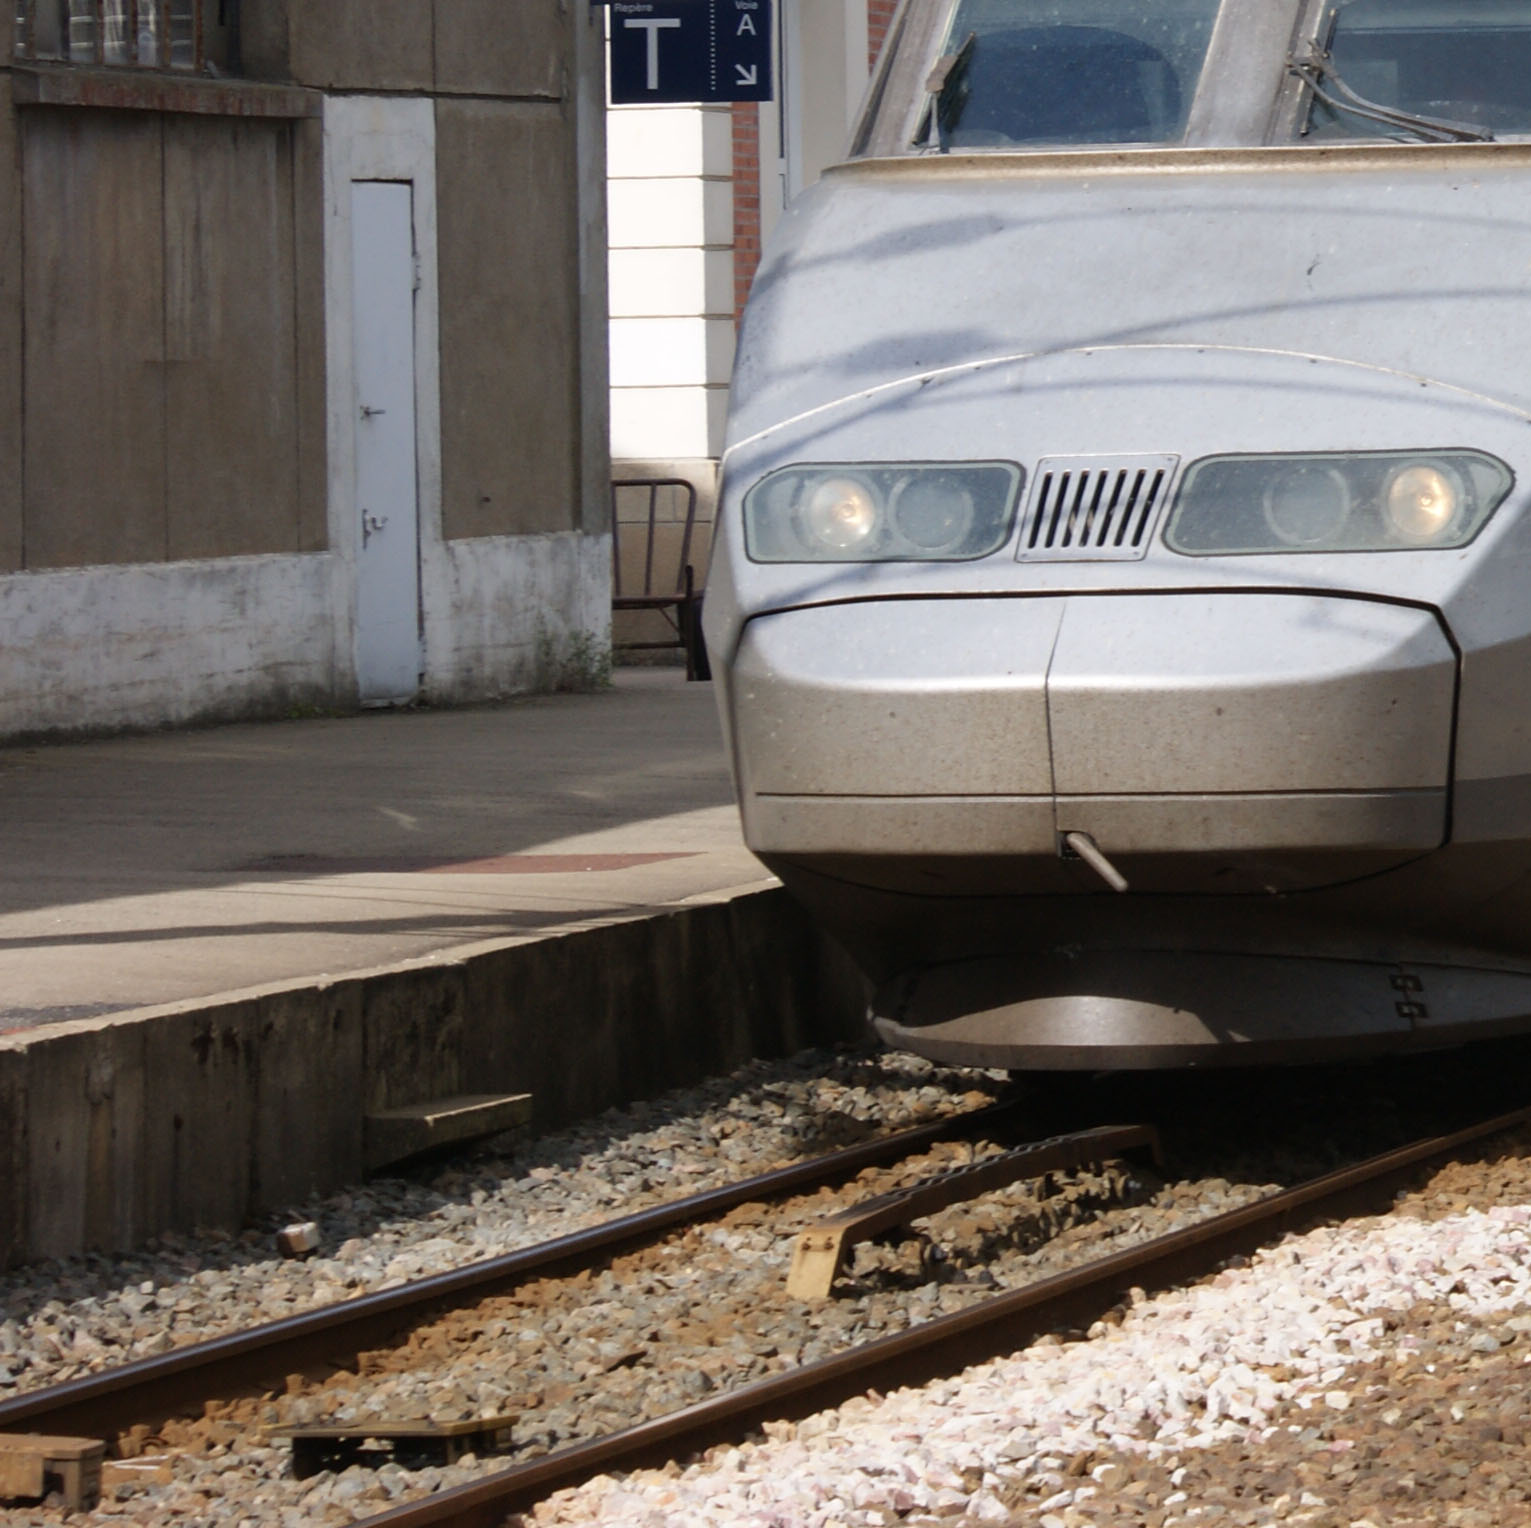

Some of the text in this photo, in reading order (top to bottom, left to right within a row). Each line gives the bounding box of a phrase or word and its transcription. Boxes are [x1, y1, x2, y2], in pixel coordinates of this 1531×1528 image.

[614, 3, 653, 14] Repère
[734, 0, 759, 10] Voie
[736, 13, 757, 36] A
[623, 17, 682, 90] T
